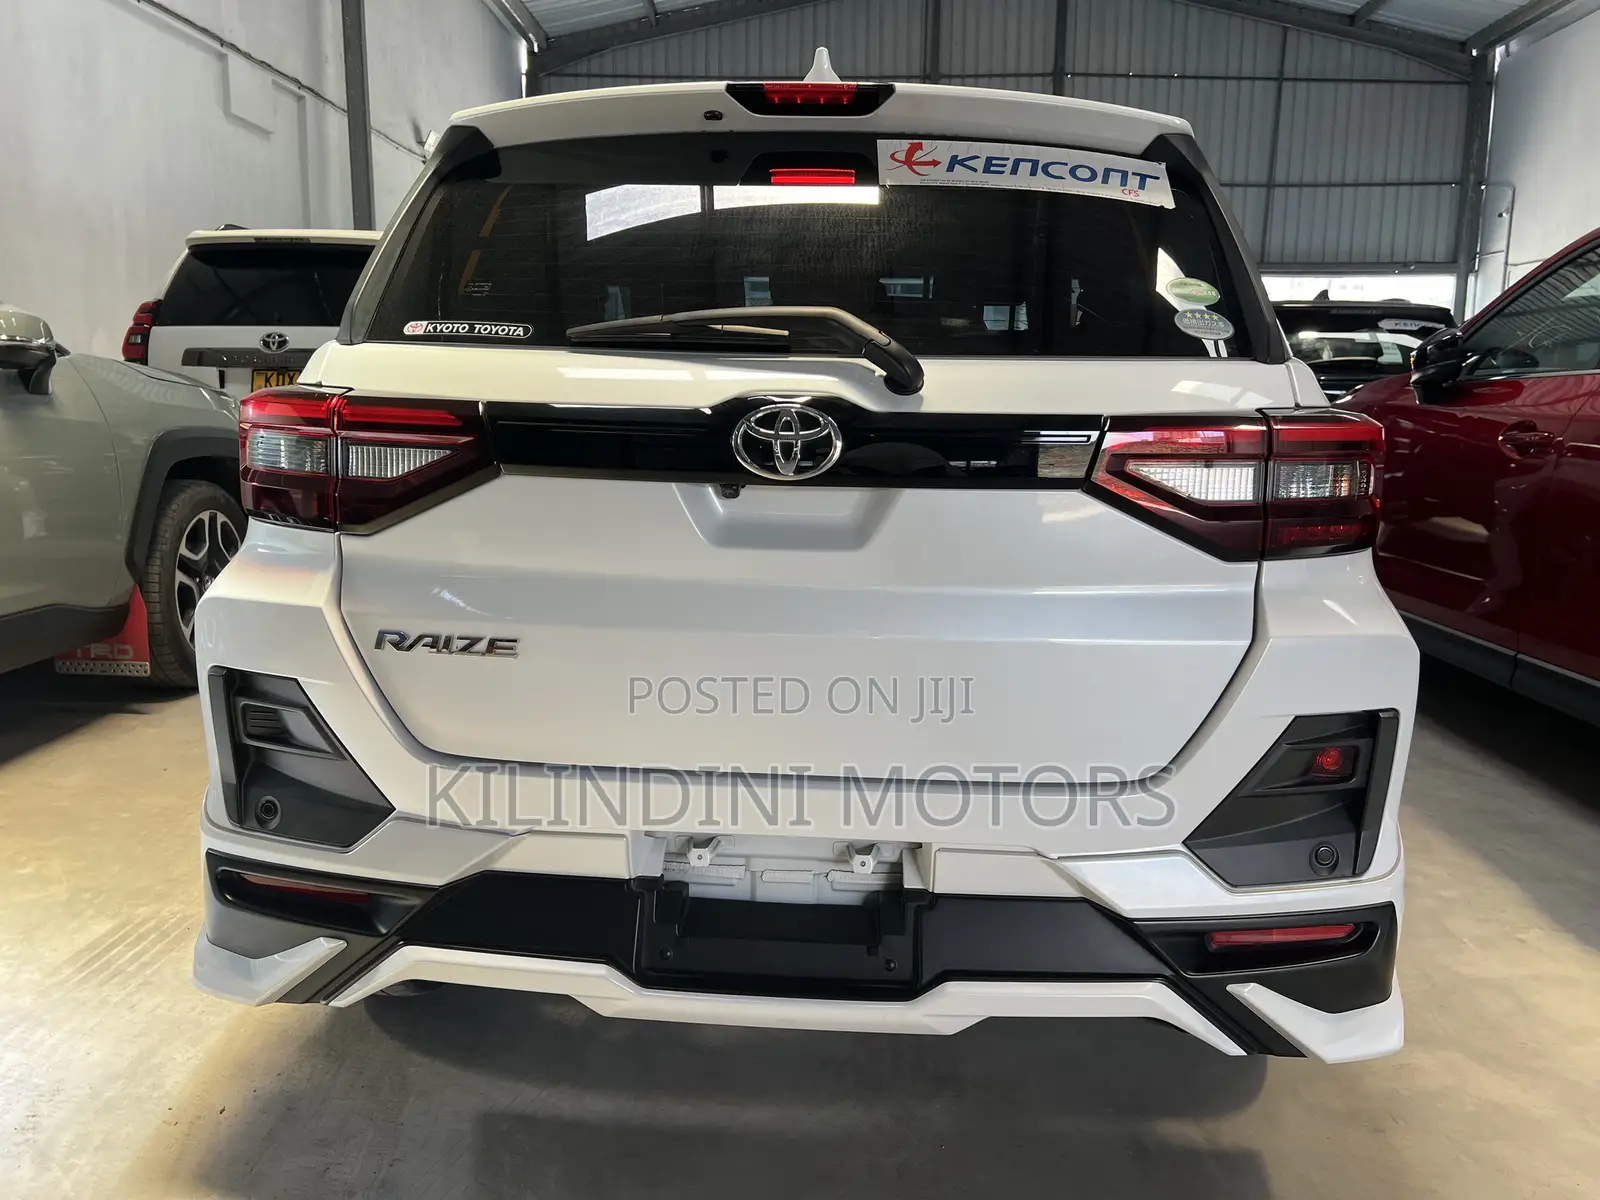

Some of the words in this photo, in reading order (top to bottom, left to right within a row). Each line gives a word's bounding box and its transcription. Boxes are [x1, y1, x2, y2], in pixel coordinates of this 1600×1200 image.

[945, 153, 1161, 191] KENCONT
[1121, 187, 1140, 198] CFS
[425, 323, 469, 333] KYOTO
[473, 324, 524, 337] TOYOTA
[374, 628, 520, 659] RAIZE
